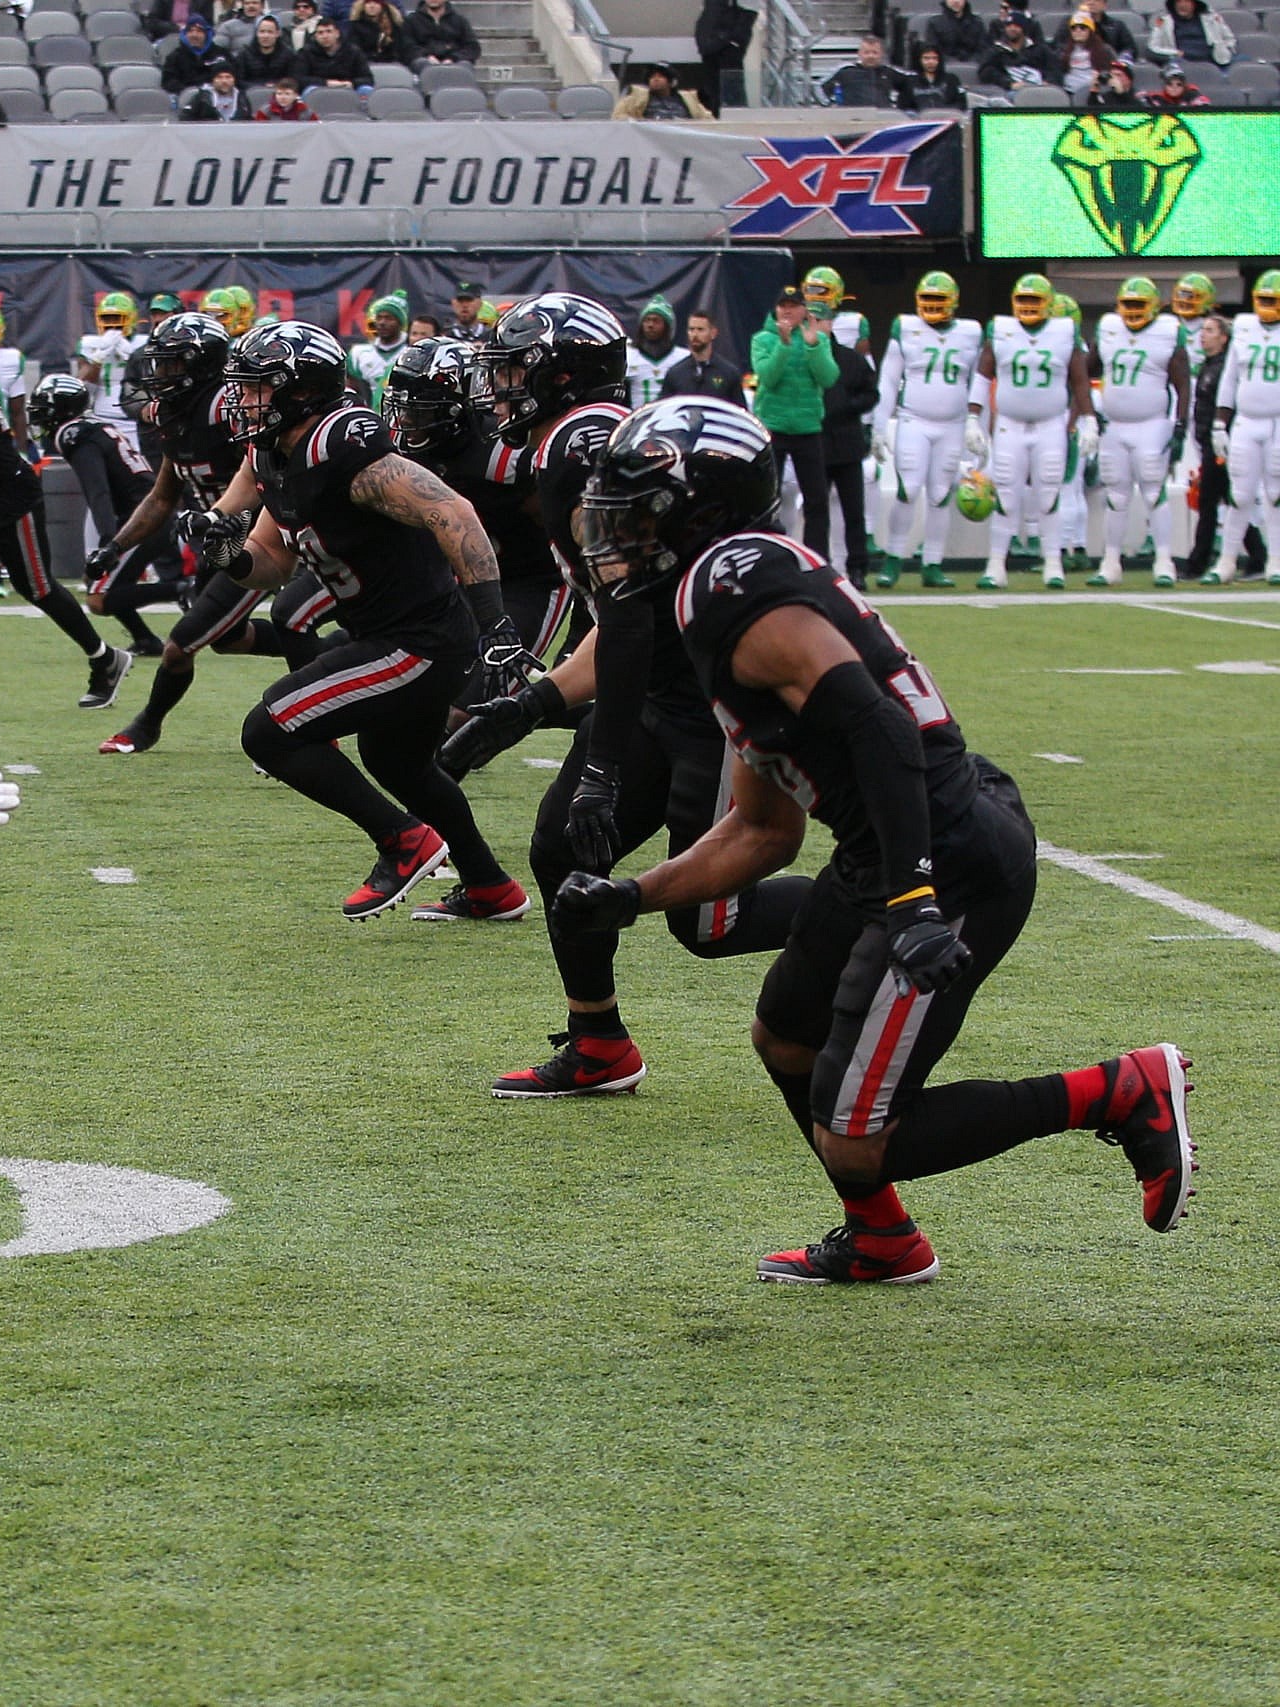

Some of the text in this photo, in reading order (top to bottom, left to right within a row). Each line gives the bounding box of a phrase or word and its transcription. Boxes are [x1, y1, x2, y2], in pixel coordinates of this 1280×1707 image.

[26, 159, 131, 208] THE
[153, 157, 297, 207] LOVE
[321, 157, 393, 206] OF
[412, 157, 696, 206] FOOTBALL
[725, 154, 932, 208] XFL
[923, 347, 961, 385] 76
[1011, 349, 1052, 388] 63
[1111, 348, 1147, 387] 67
[1248, 343, 1280, 383] 78
